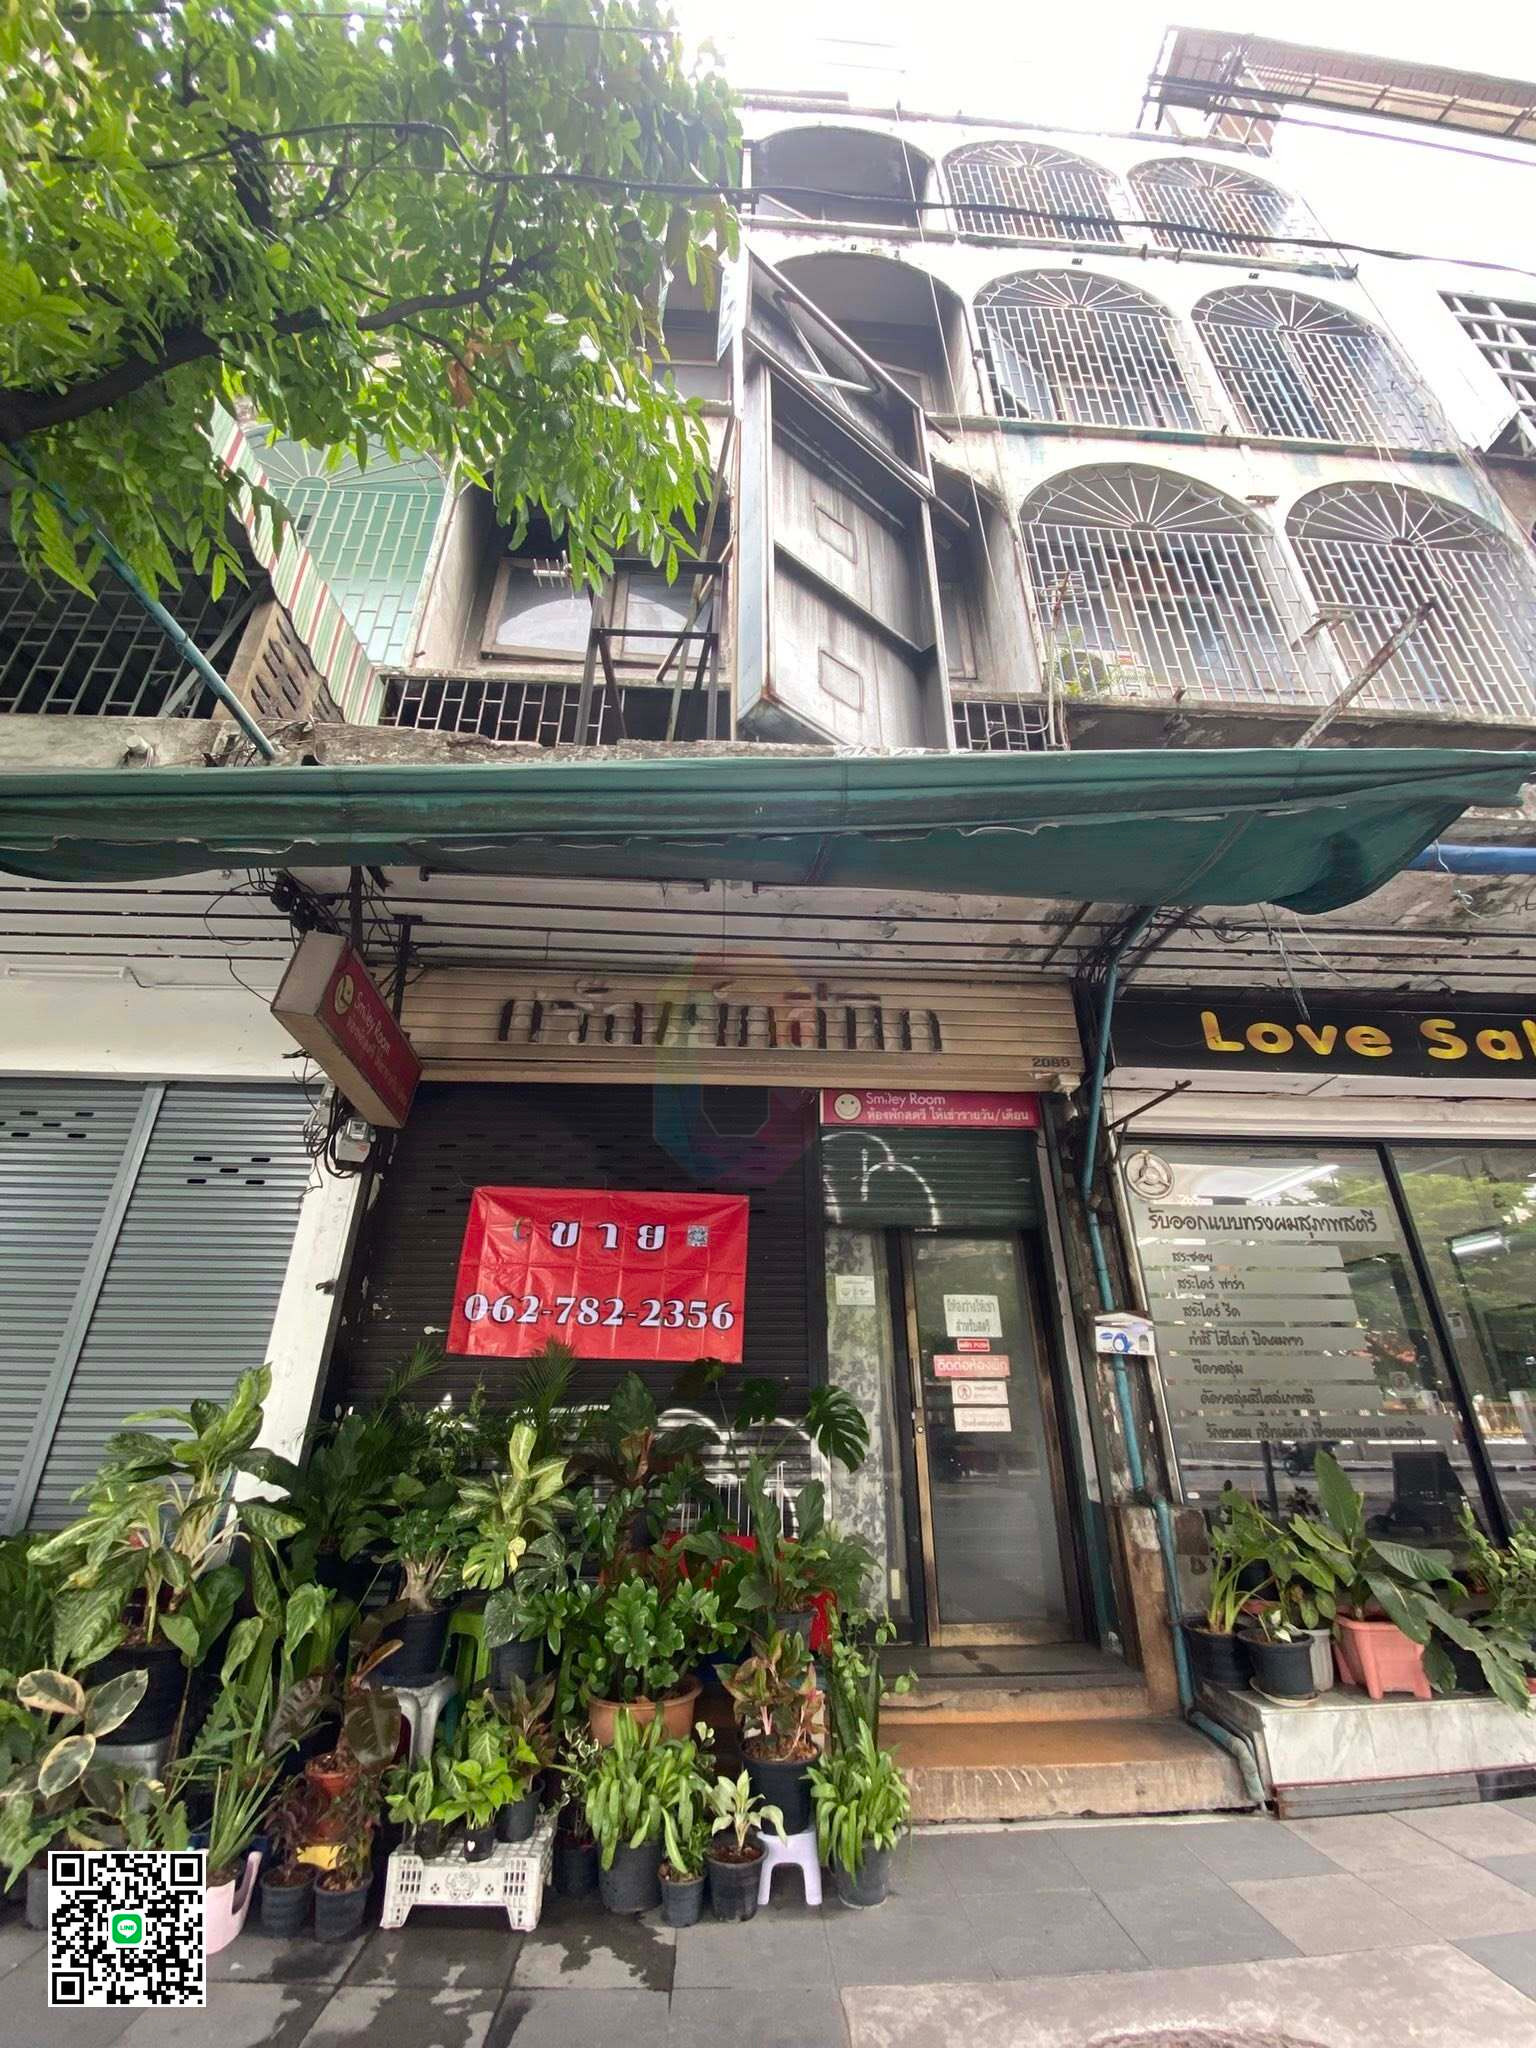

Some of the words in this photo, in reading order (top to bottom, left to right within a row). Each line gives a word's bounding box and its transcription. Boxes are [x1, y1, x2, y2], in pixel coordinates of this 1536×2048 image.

[1201, 1010, 1393, 1057] Love
[866, 1092, 906, 1108] Smiley
[909, 1093, 946, 1105] Room
[866, 1107, 927, 1121] ห้องพักสตรี
[551, 1220, 667, 1251] ขาย
[1148, 1208, 1378, 1238] รับออกแบบทรงผมสุภาพสตรี
[464, 1293, 735, 1330] 062-782-2356
